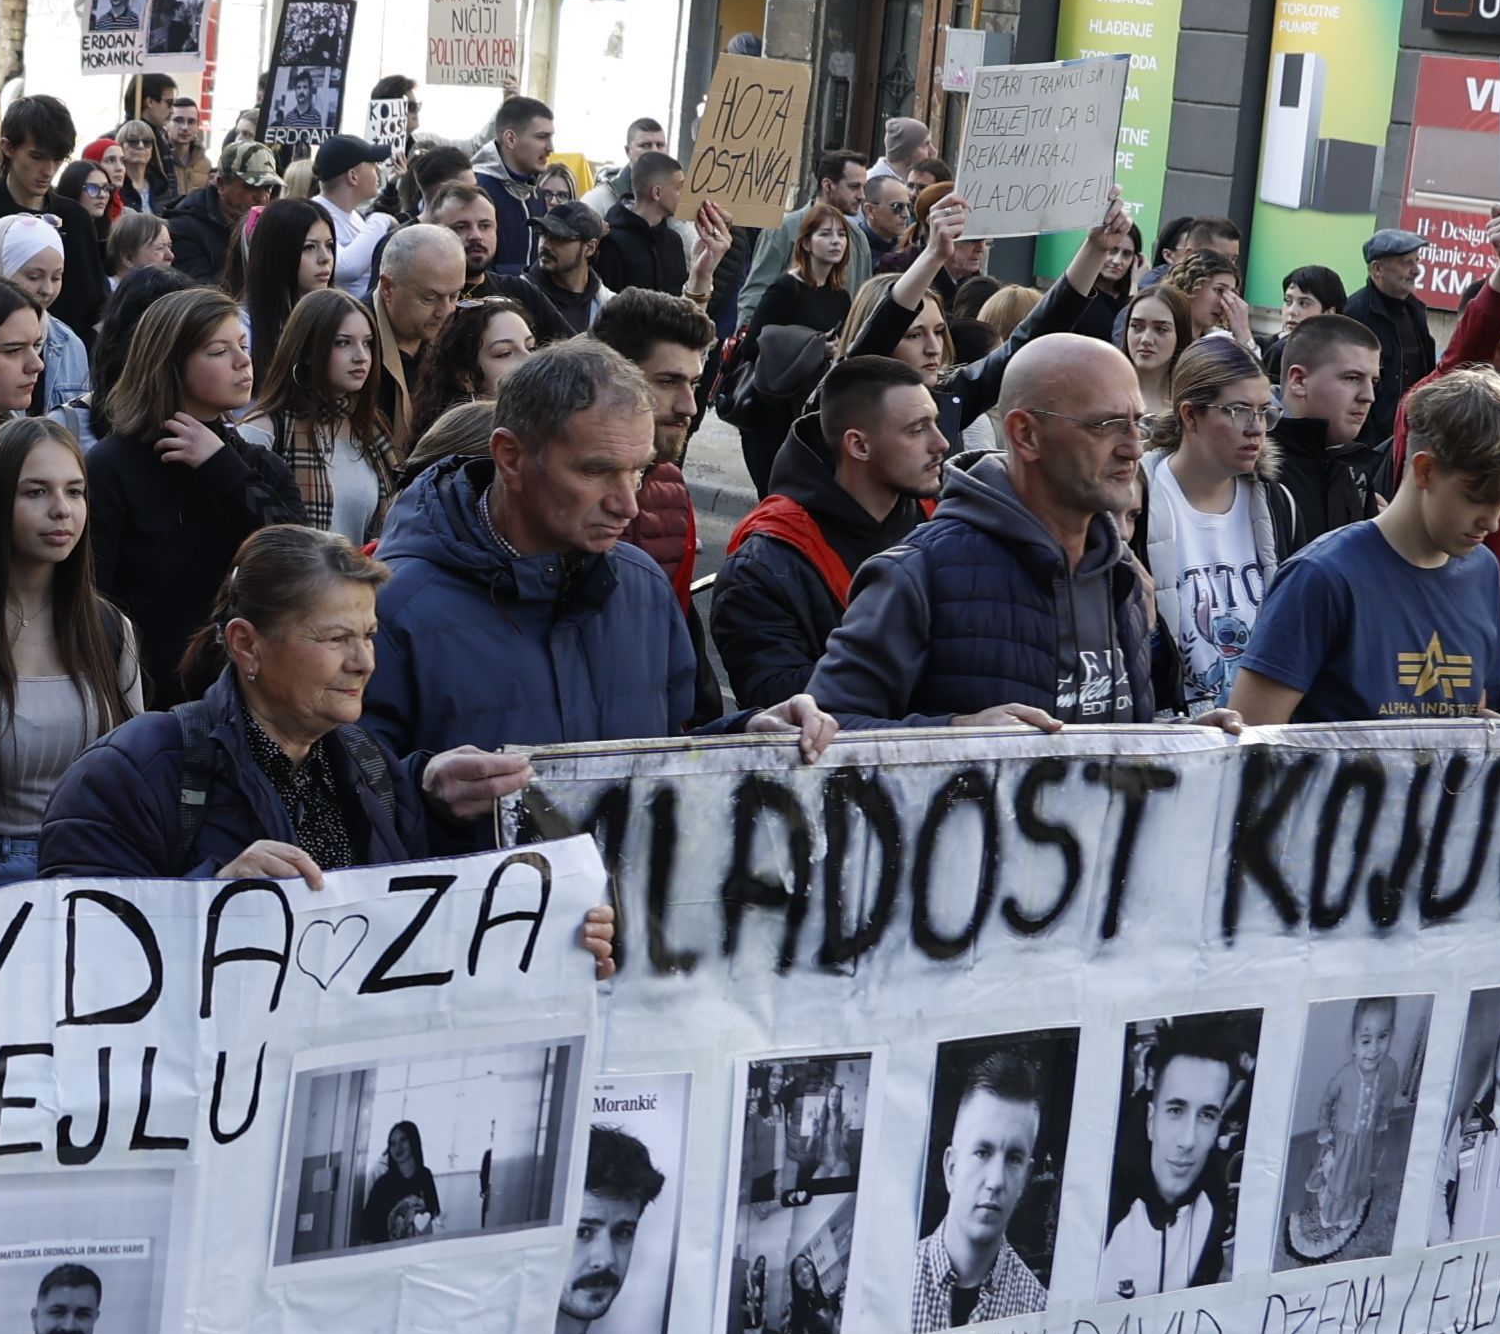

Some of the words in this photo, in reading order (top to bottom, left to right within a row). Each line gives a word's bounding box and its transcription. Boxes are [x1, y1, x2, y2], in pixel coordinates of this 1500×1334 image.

[452, 4, 497, 33] NIČIJI
[1281, 2, 1341, 20] TOPLOTNE
[1089, 19, 1154, 38] HLAĐENJE
[1279, 20, 1320, 35] PUMPE
[82, 33, 136, 51] ERDOAN
[429, 34, 488, 67] POLITIČKI
[1130, 54, 1157, 71] ODA
[977, 75, 1022, 100] STARI
[712, 76, 793, 150] HOTA
[1059, 107, 1078, 131] DA
[1086, 103, 1100, 126] BI
[691, 146, 791, 207] OSTAVKA
[1468, 250, 1482, 267] za
[1431, 268, 1473, 295] KM
[1378, 701, 1417, 715] ALPHA
[358, 852, 552, 995] ZA
[593, 1093, 657, 1113] Morankić
